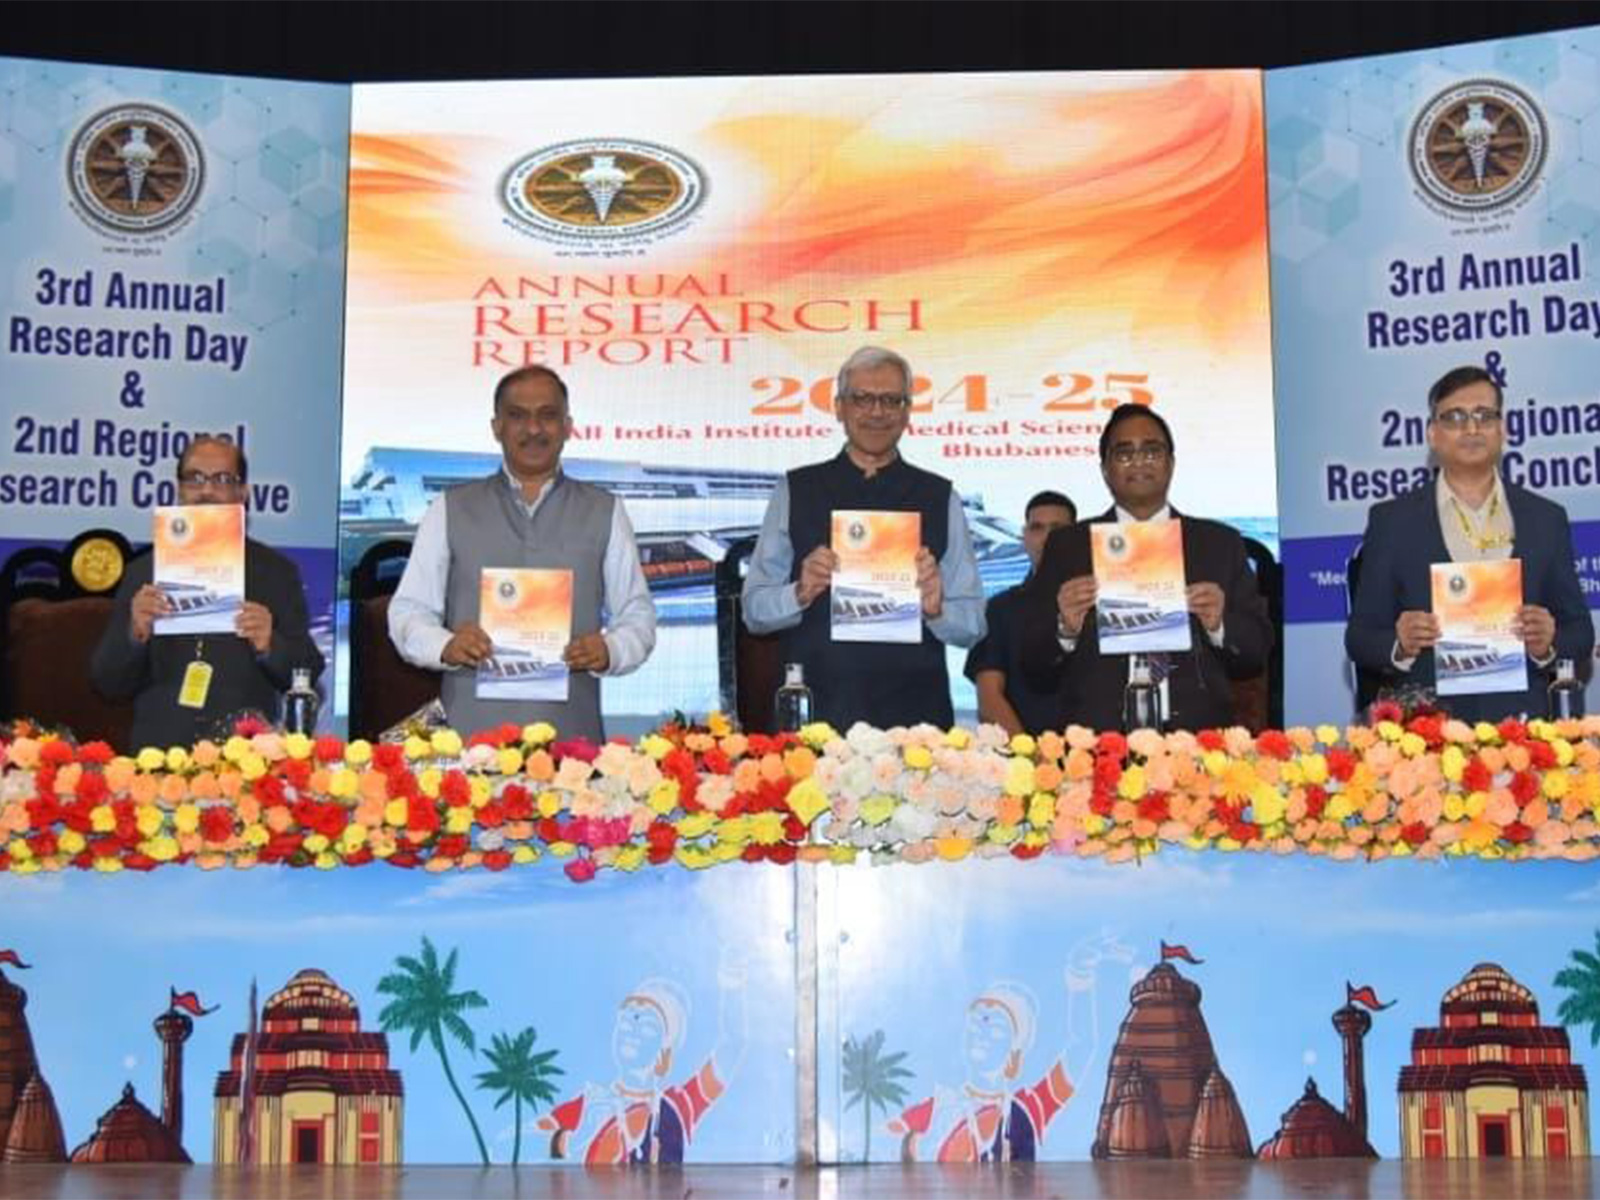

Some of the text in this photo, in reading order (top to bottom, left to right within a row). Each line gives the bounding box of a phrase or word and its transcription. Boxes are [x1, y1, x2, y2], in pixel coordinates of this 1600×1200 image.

[473, 273, 744, 300] ANNUAL
[1389, 243, 1581, 297] 3rd Annual
[36, 268, 225, 313] 3rd Annual
[474, 299, 923, 337] RESEARCH
[1367, 299, 1530, 348] Research
[10, 316, 248, 371] Research Day
[473, 337, 749, 367] REPORT
[120, 370, 144, 408] &
[14, 416, 244, 466] 2nd Regiol
[615, 424, 692, 440] India
[705, 422, 833, 439] Institute
[1020, 419, 1102, 437] Scien
[1381, 410, 1431, 447] 2n
[942, 442, 1096, 458] Bhubanes
[1327, 464, 1440, 501] Resea
